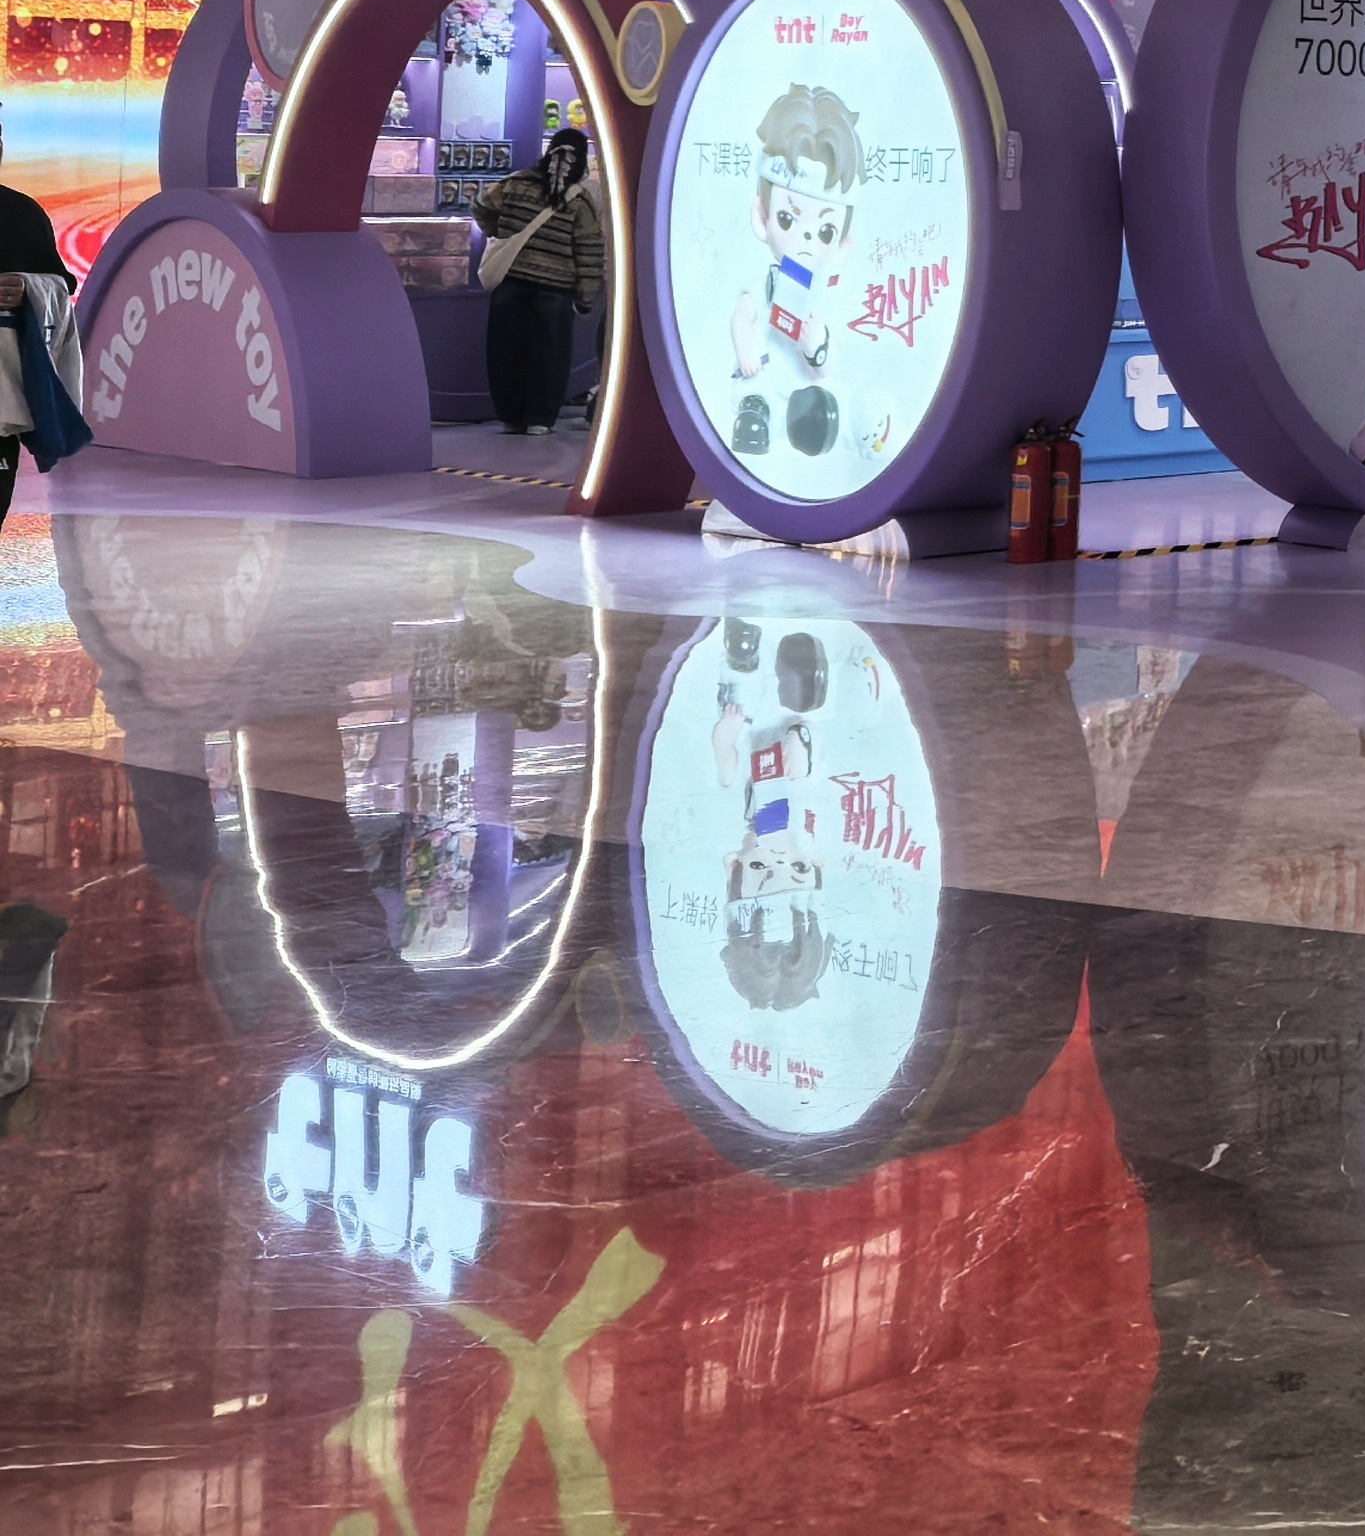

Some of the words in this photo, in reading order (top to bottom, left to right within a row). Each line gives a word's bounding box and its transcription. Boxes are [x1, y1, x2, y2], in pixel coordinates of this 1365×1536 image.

[774, 15, 816, 44] tnt
[831, 28, 869, 46] Rayan
[840, 13, 865, 30] Boy
[693, 141, 753, 178] 下课铃
[865, 144, 956, 184] 终于响了
[92, 295, 148, 422] the
[150, 249, 236, 315] new
[235, 286, 281, 442] toy
[1124, 354, 1200, 432] t
